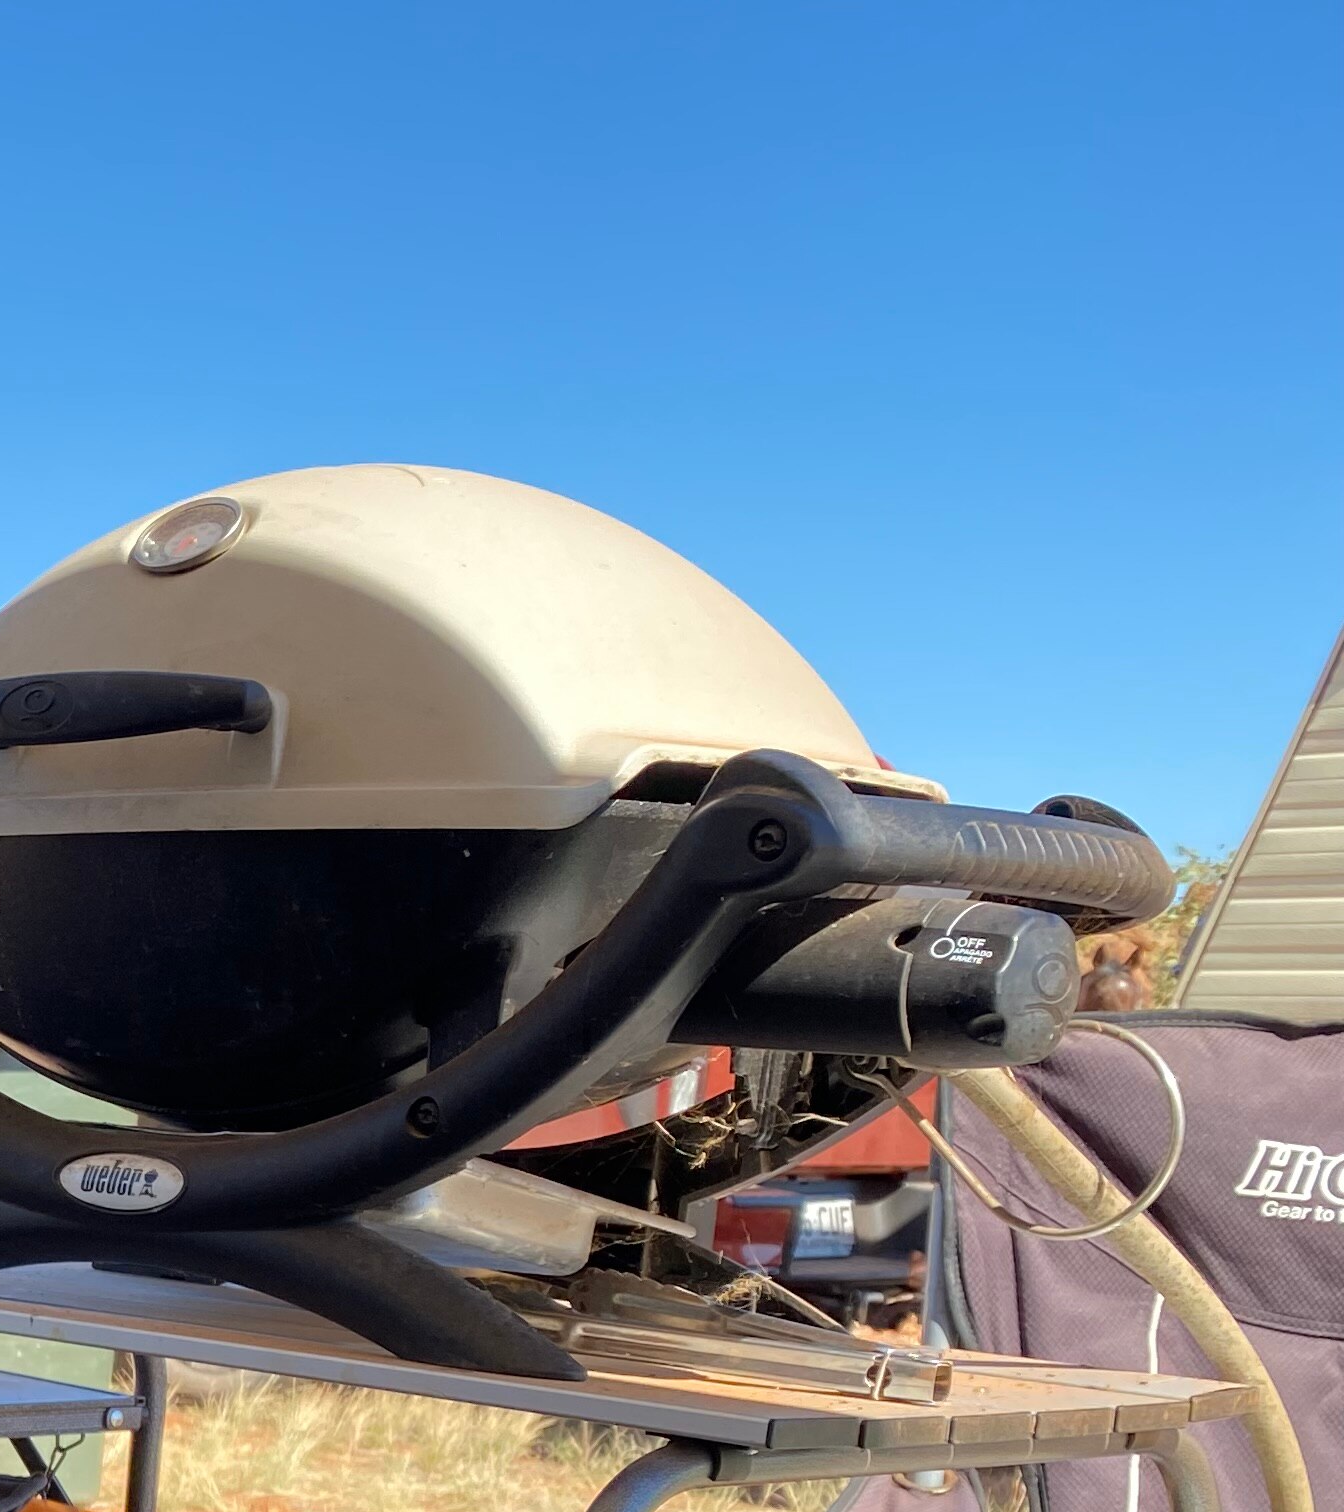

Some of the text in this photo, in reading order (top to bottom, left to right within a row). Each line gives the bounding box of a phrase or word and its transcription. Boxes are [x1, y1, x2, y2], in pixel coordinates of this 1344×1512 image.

[957, 936, 987, 949] OFF
[953, 947, 993, 958] APAGADO
[80, 1160, 144, 1197] weber
[1261, 1200, 1313, 1220] Gear
[1314, 1205, 1335, 1222] to
